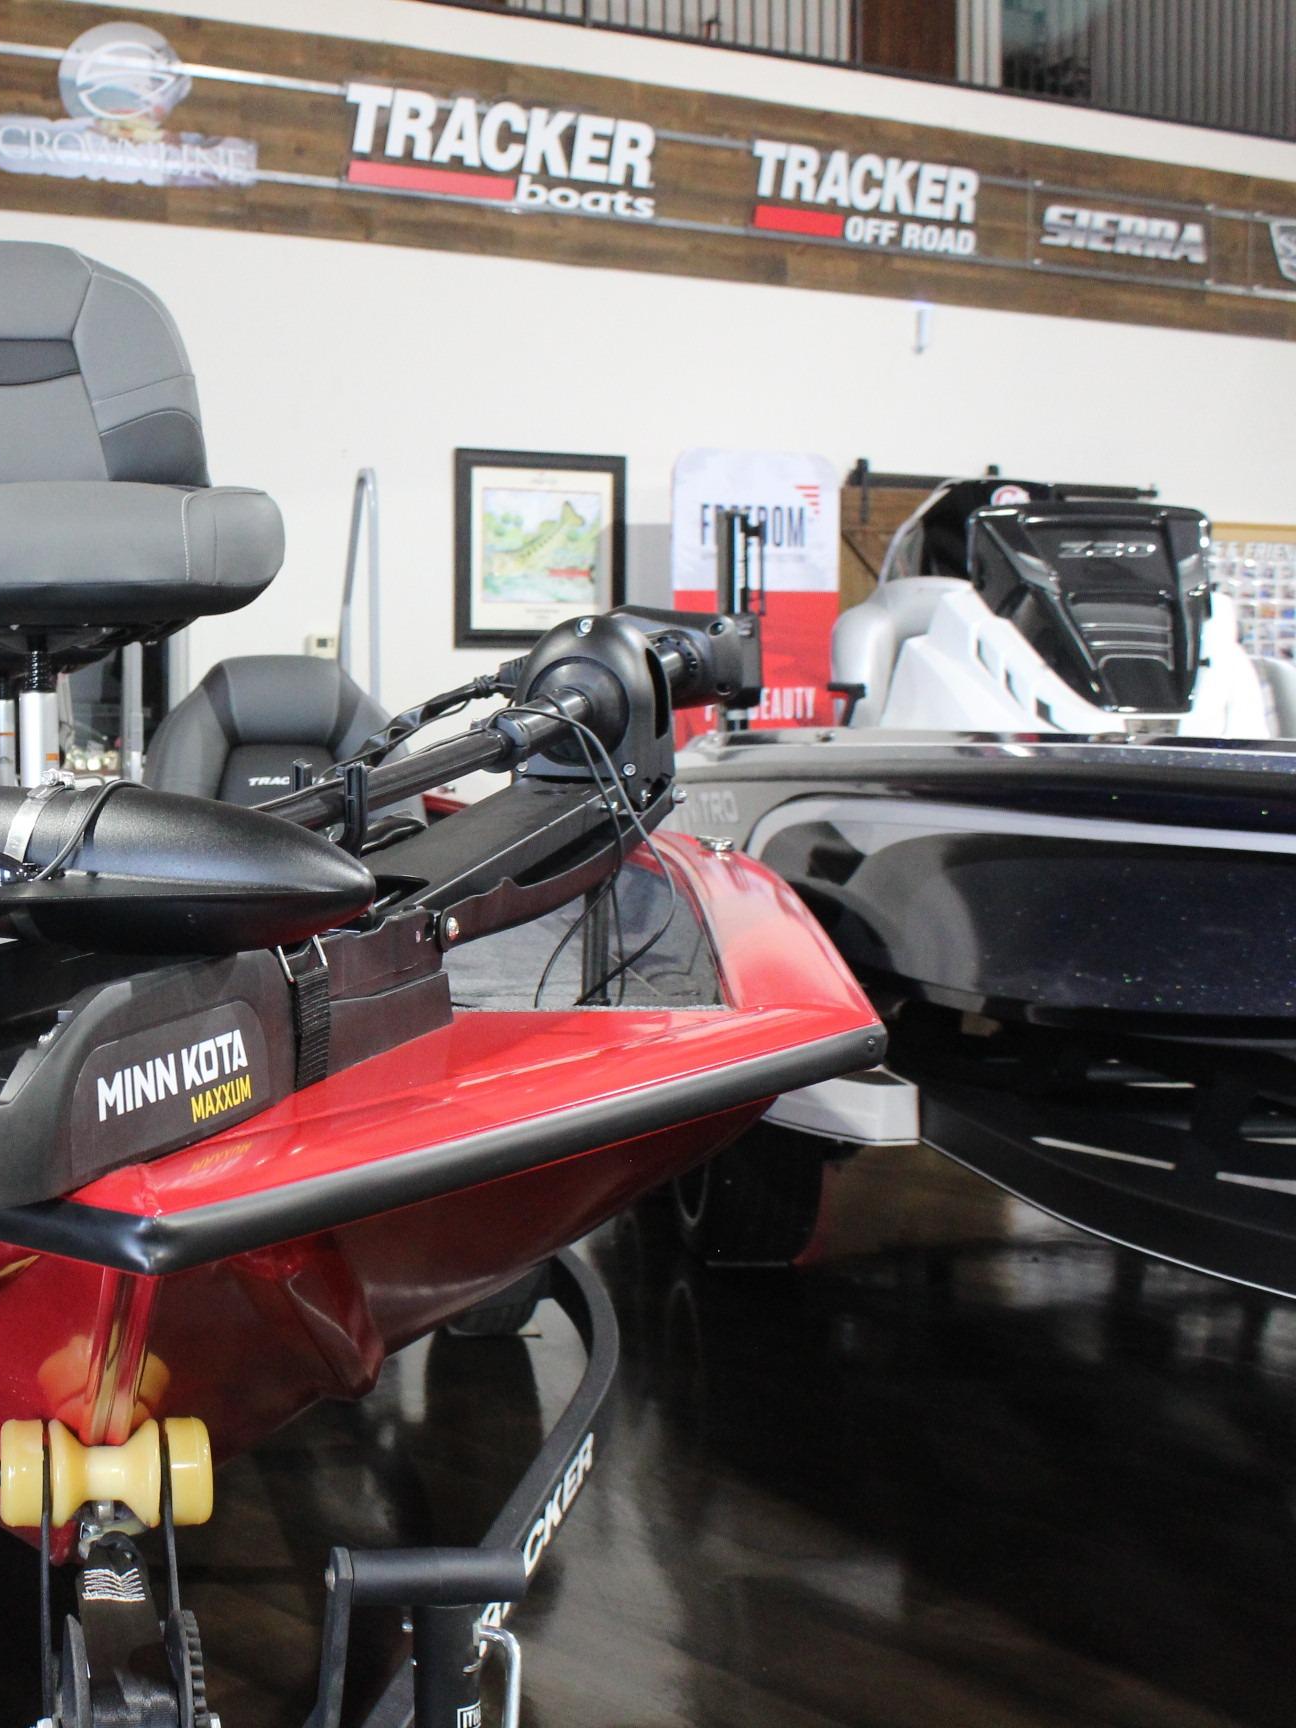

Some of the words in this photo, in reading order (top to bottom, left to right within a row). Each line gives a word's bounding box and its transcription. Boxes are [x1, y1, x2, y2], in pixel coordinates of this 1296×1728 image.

[346, 82, 655, 189] TRACKER
[516, 174, 655, 219] boats
[753, 139, 980, 223] TRACKER
[844, 215, 900, 246] OFF
[902, 222, 977, 256] ROAD
[1040, 205, 1208, 265] SIERRA
[97, 1053, 179, 1122] MINN
[181, 1029, 249, 1090] KOTA
[191, 1074, 252, 1123] MAXXUM
